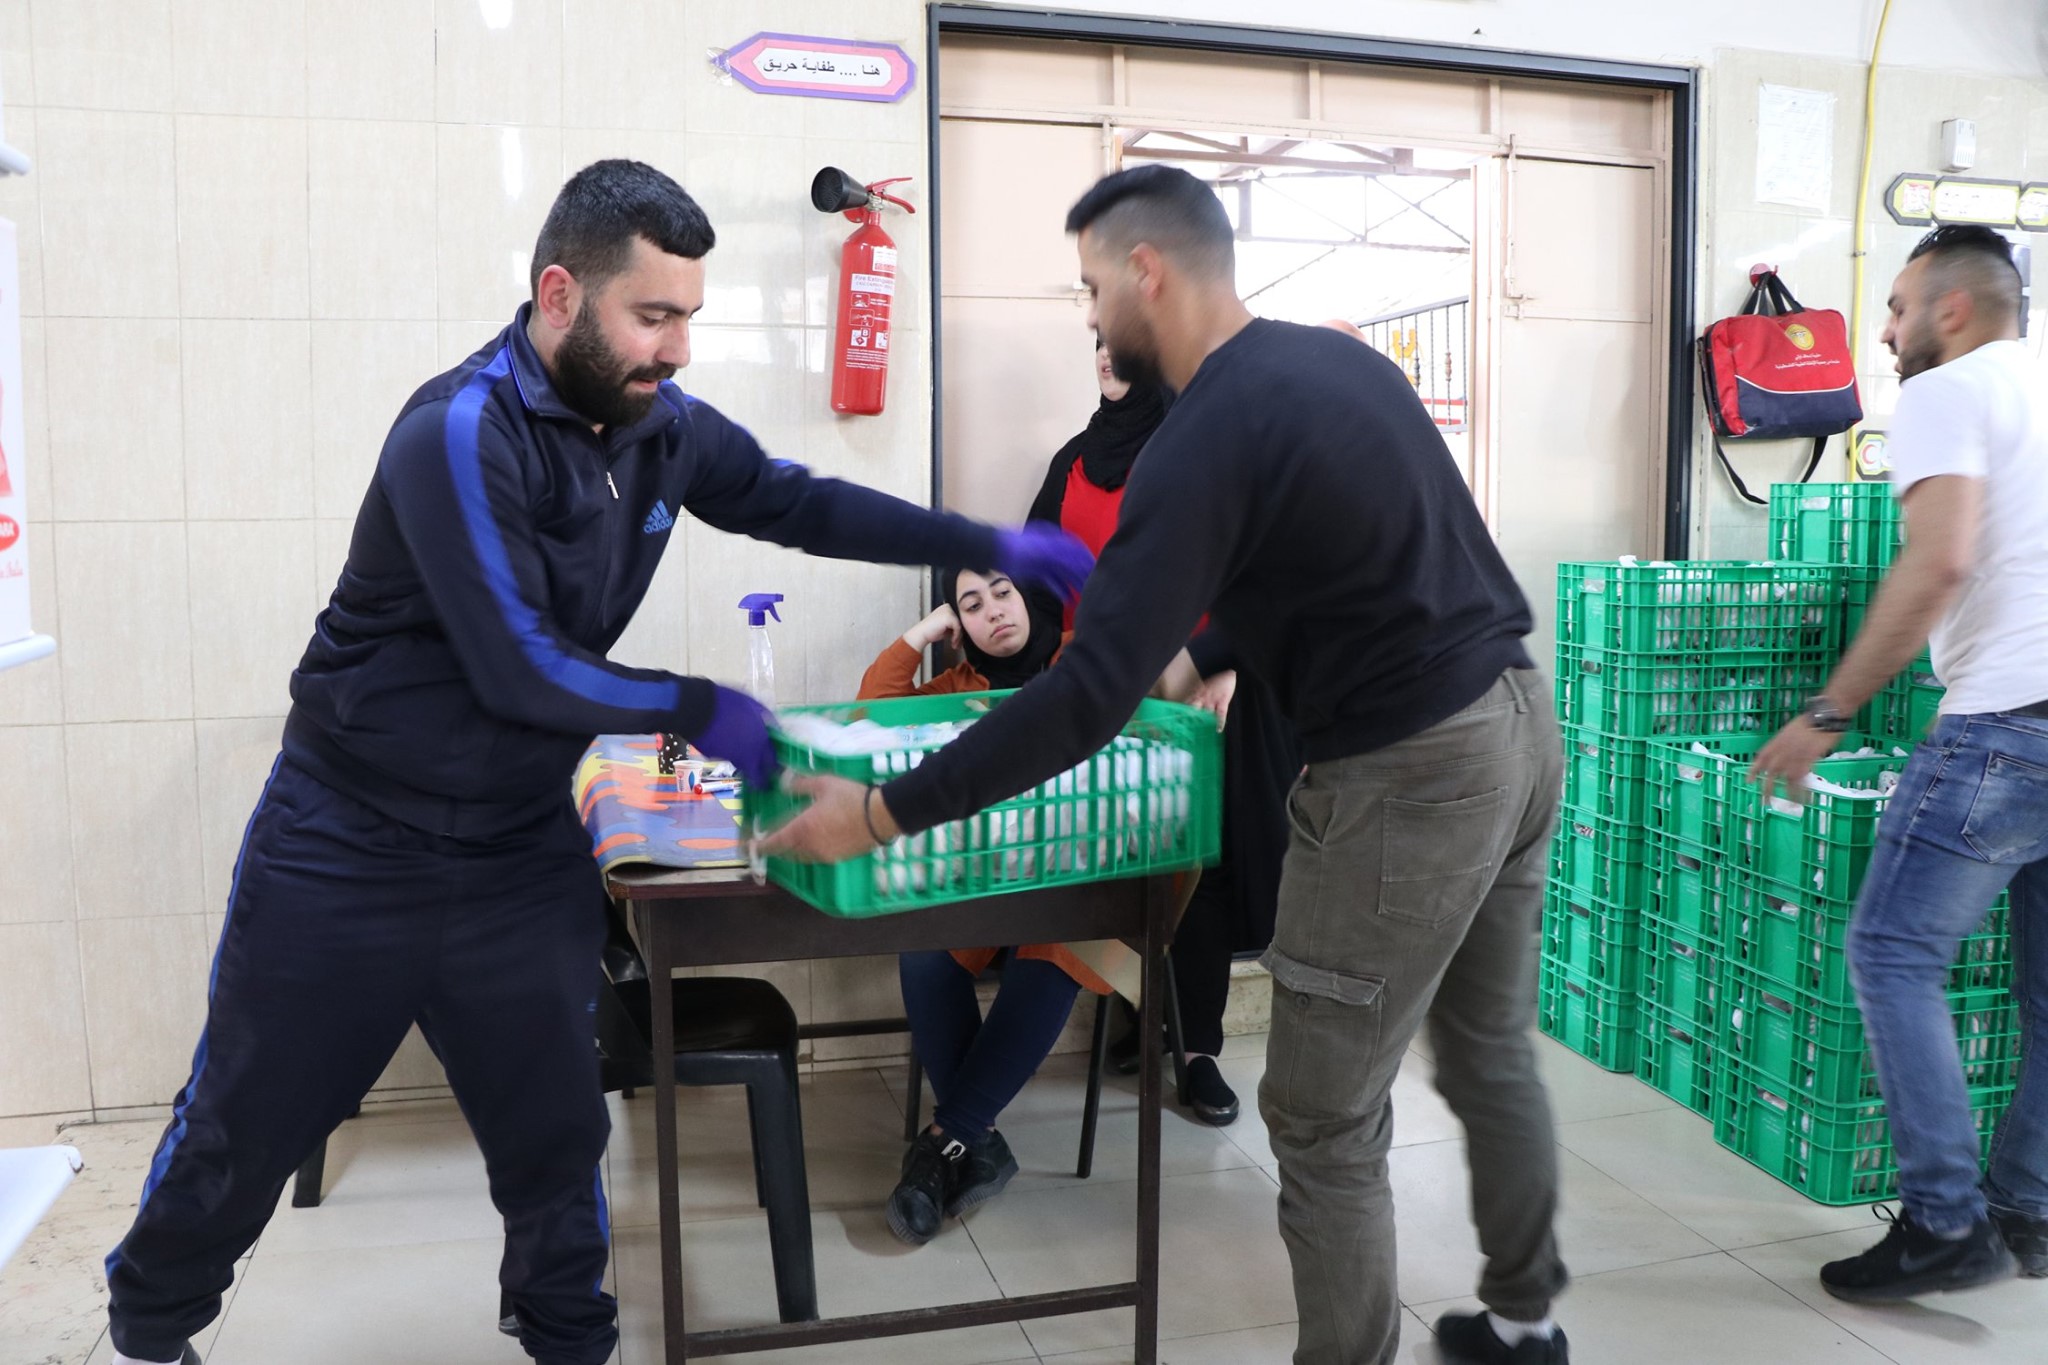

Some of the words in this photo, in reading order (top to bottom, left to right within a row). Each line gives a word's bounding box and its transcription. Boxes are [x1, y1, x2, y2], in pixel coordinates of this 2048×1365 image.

[763, 59, 798, 72] حريق
[802, 58, 835, 74] طفاية
[862, 64, 880, 76] هنا
[643, 515, 673, 534] adidas
